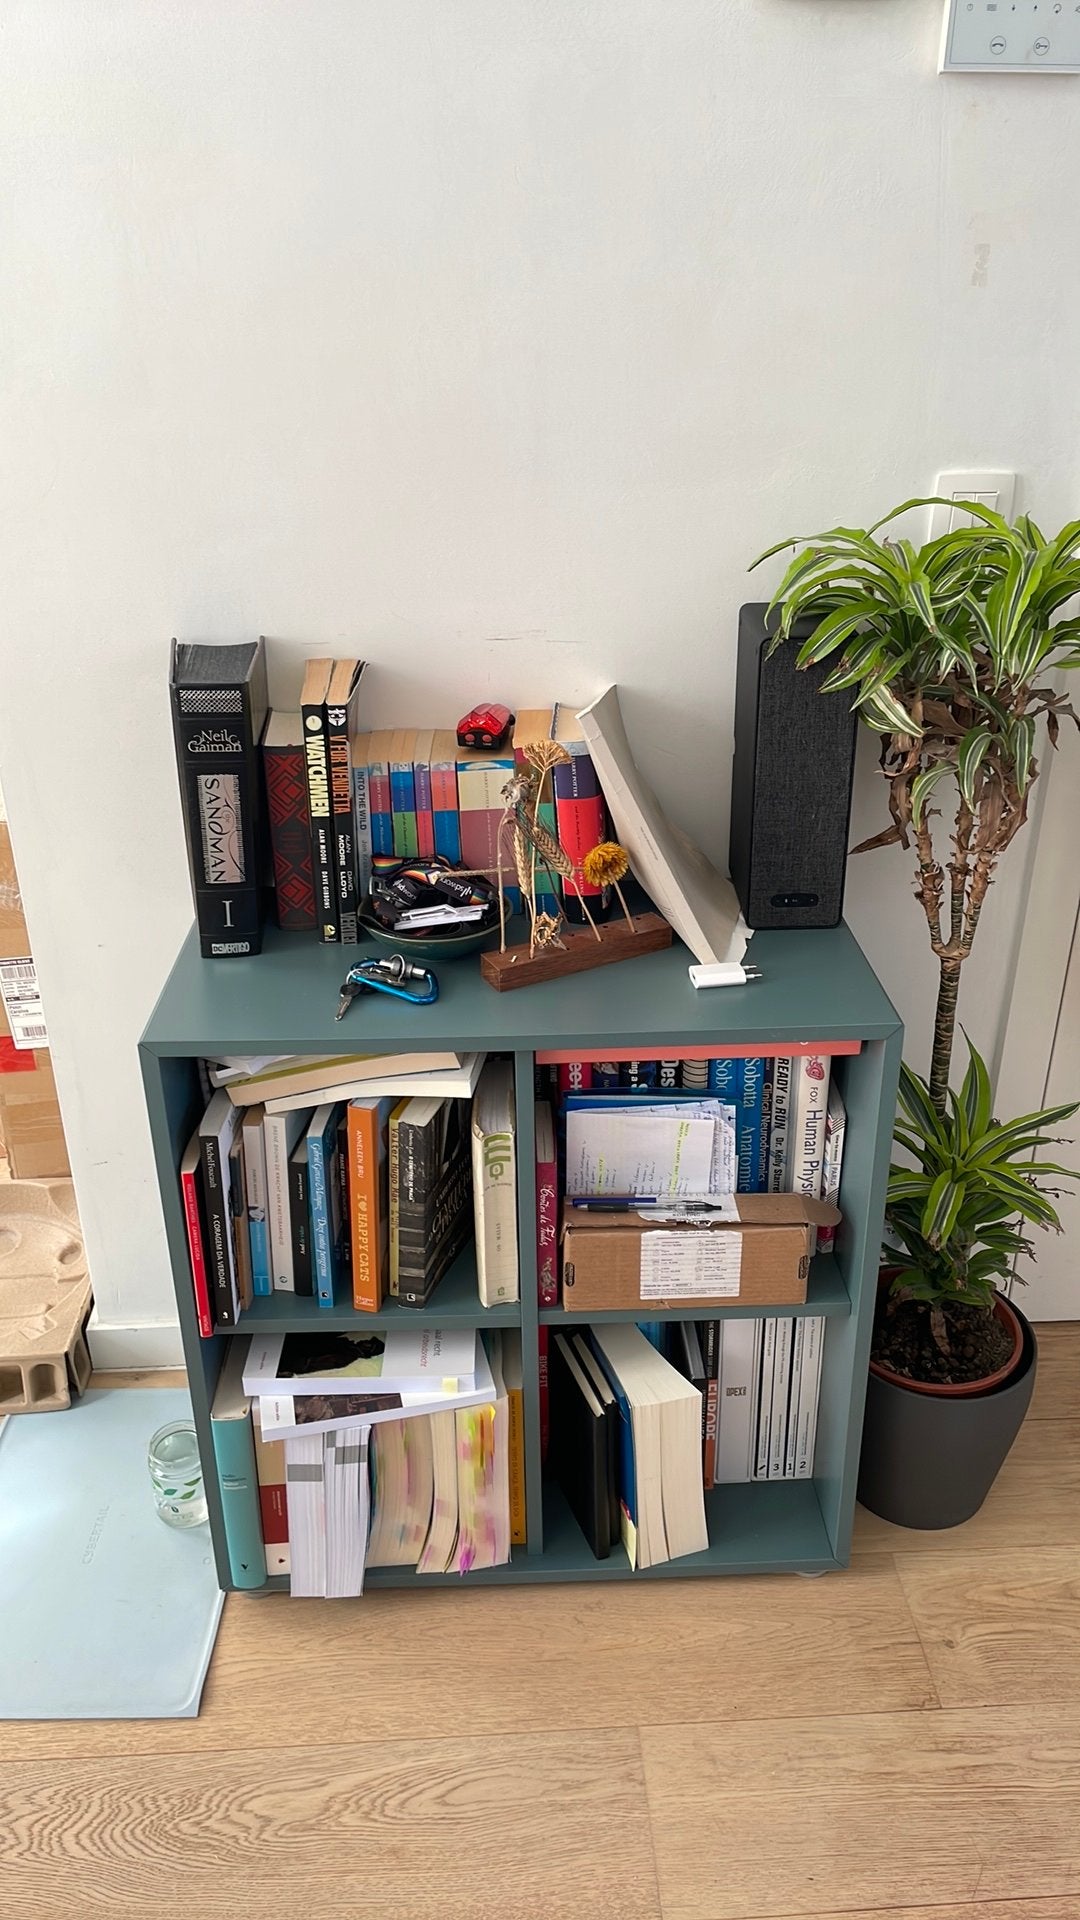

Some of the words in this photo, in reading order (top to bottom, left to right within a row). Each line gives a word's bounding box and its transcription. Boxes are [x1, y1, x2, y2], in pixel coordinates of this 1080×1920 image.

[196, 728, 233, 742] Neil
[330, 735, 350, 743] V
[188, 740, 243, 753] Gaiman
[330, 745, 349, 763] FOR
[305, 734, 331, 817] WATCHMEN
[357, 771, 365, 790] INTO
[331, 766, 351, 814] VENDETTA
[358, 792, 367, 811] THE
[204, 778, 228, 882] SANDMAN
[359, 813, 368, 830] WILD
[318, 829, 326, 843] ALAN
[320, 844, 328, 864] MOORE
[338, 835, 346, 866] MOORE
[321, 871, 329, 884] DAVE
[340, 871, 348, 899] LLOYD
[346, 871, 354, 891] DAVID
[322, 886, 331, 909] GIBBONS
[743, 1057, 761, 1108] Sobotta
[776, 1057, 790, 1093] READY
[761, 1082, 773, 1114] Clinical
[775, 1095, 785, 1105] to
[809, 1087, 819, 1104] FOX
[774, 1107, 787, 1130] RUN
[391, 1127, 399, 1160] Valter
[775, 1137, 784, 1148] Dr.
[804, 1110, 823, 1156] Human
[205, 1142, 216, 1163] Michel
[310, 1143, 322, 1164] Gabriel
[356, 1130, 364, 1163] ANNELEEN
[757, 1115, 771, 1182] Neurodynamics
[740, 1125, 756, 1191] Anatomie
[772, 1149, 783, 1167] Kelly
[207, 1163, 218, 1188] Foucault
[357, 1164, 365, 1179] BRU
[390, 1163, 399, 1185] Hugo
[540, 1215, 552, 1224] de
[212, 1220, 223, 1250] CORAGEM
[358, 1212, 369, 1252] HAPPY
[539, 1225, 556, 1246] Fadas
[216, 1251, 224, 1260] DA
[217, 1261, 226, 1288] VERDADE
[360, 1253, 370, 1282] CATS
[539, 1355, 548, 1373] BIKE
[540, 1375, 548, 1388] FIT
[788, 1463, 792, 1471] 1
[799, 1461, 806, 1469] 2
